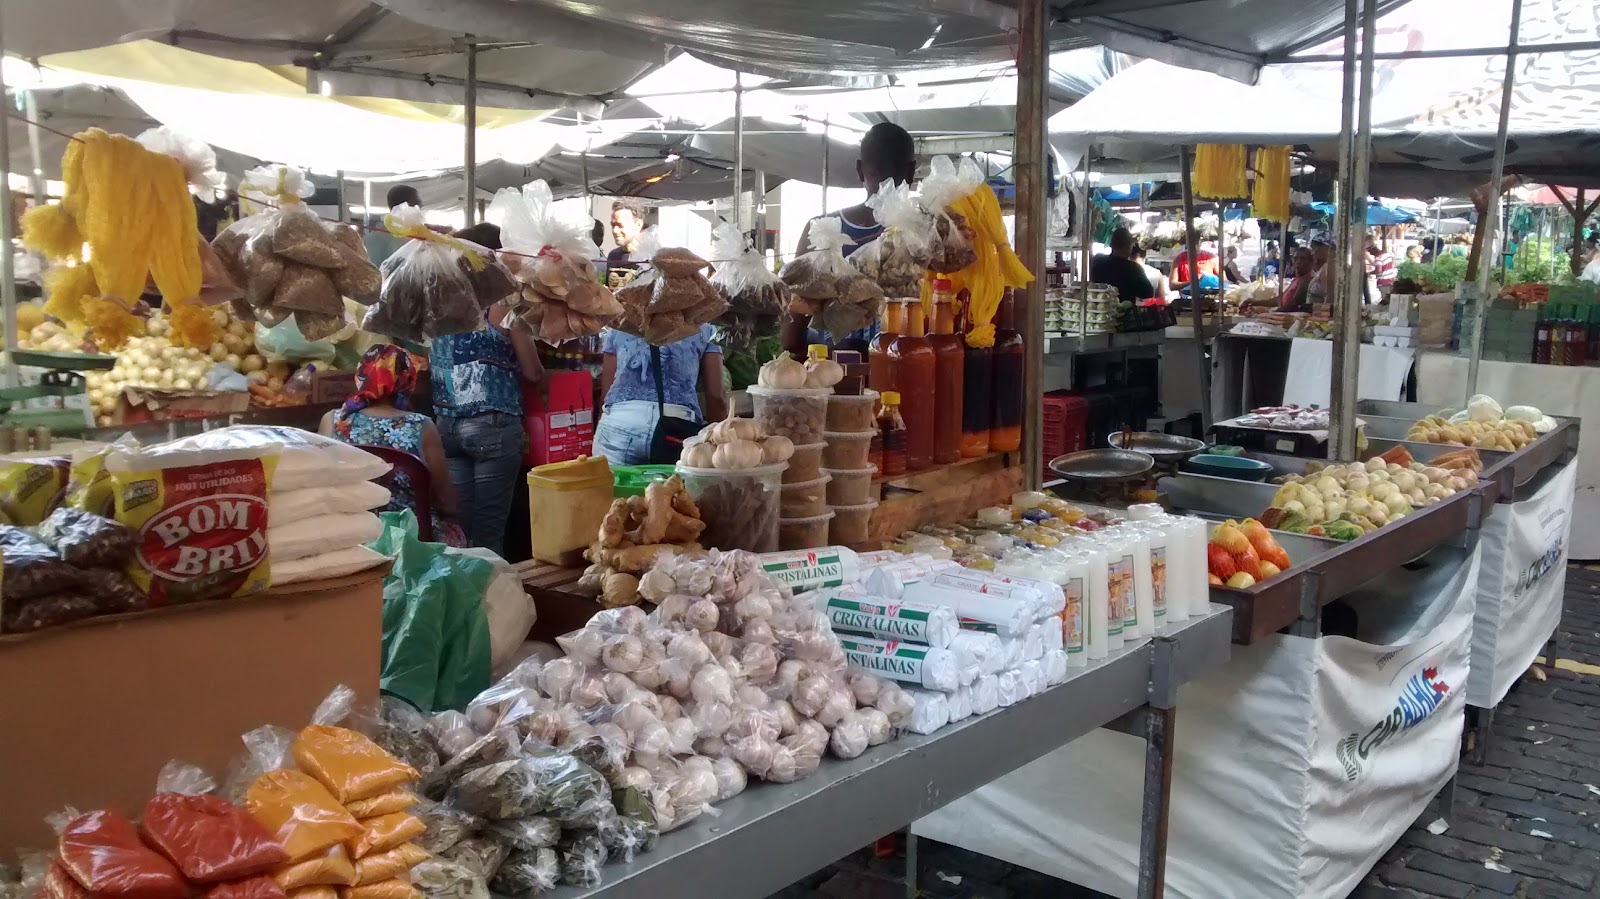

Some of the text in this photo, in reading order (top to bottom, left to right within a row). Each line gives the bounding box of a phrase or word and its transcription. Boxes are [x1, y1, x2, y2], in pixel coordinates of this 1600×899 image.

[175, 474, 254, 492] 1001 UTILIDADES
[152, 500, 251, 548] BOM
[832, 610, 920, 637] CRISTALINAS
[846, 652, 915, 676] ISTALINAS
